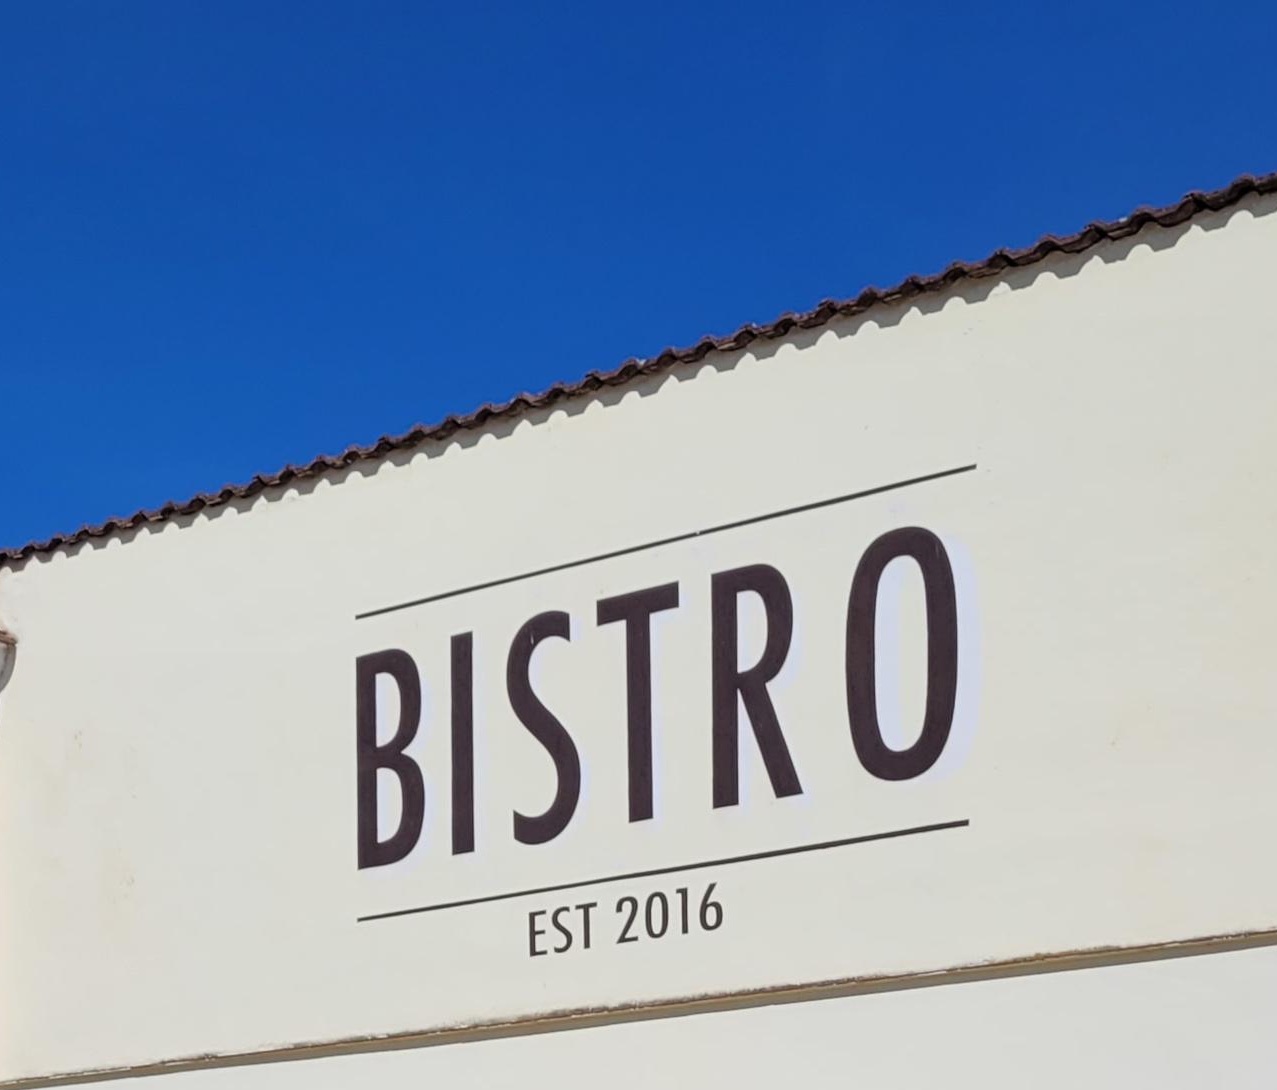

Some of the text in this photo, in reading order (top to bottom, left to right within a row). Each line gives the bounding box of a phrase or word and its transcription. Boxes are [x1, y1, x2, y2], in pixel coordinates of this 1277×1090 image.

[356, 526, 958, 870] BISTRO
[528, 882, 723, 957] EST 2016
